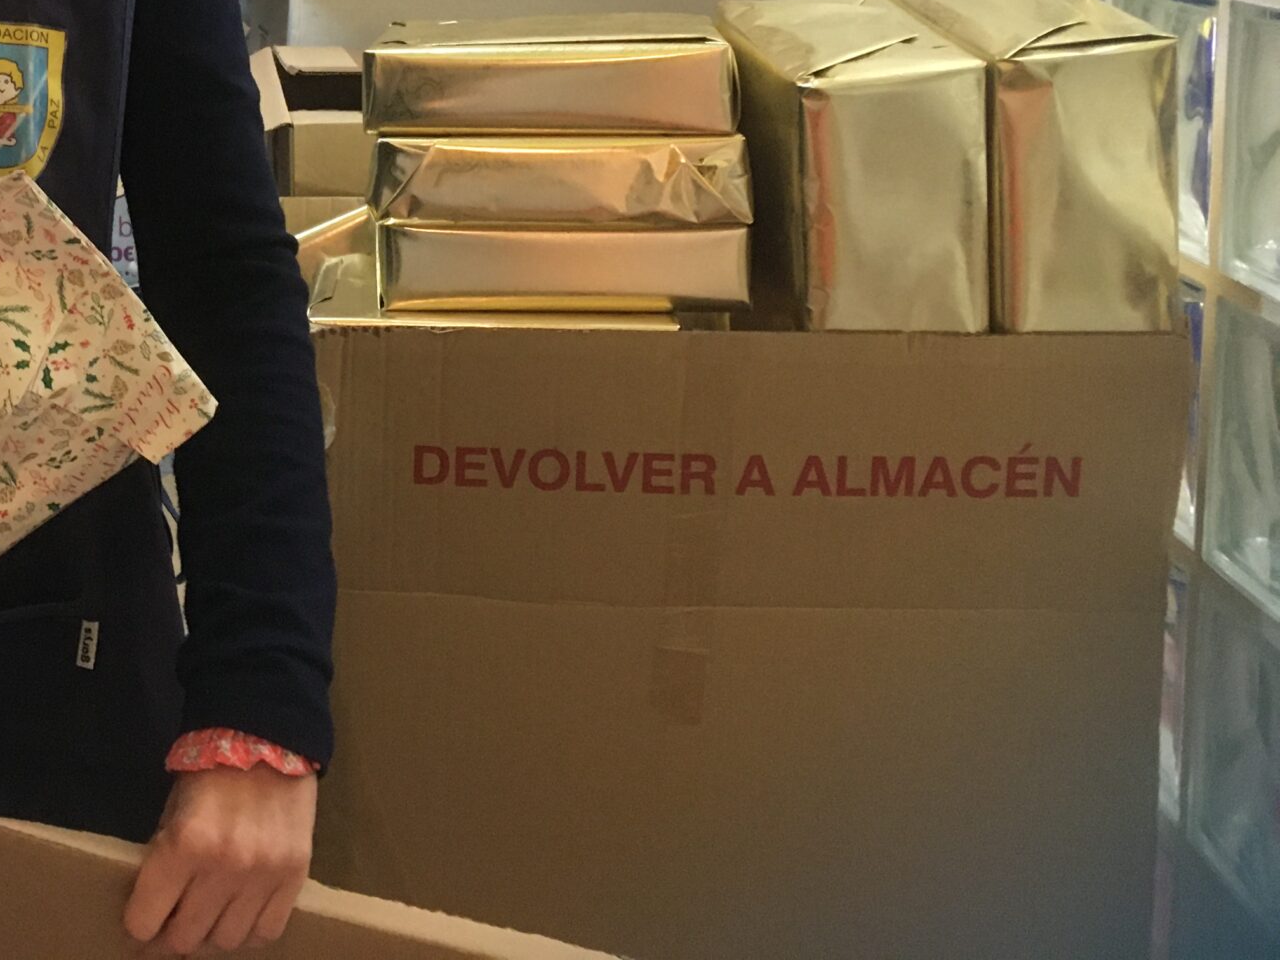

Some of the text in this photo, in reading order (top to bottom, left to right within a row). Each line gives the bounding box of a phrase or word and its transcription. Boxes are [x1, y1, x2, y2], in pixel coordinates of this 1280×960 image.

[47, 98, 60, 129] PAZ
[413, 442, 1083, 498] DEVOLVER A ALMACÉN
